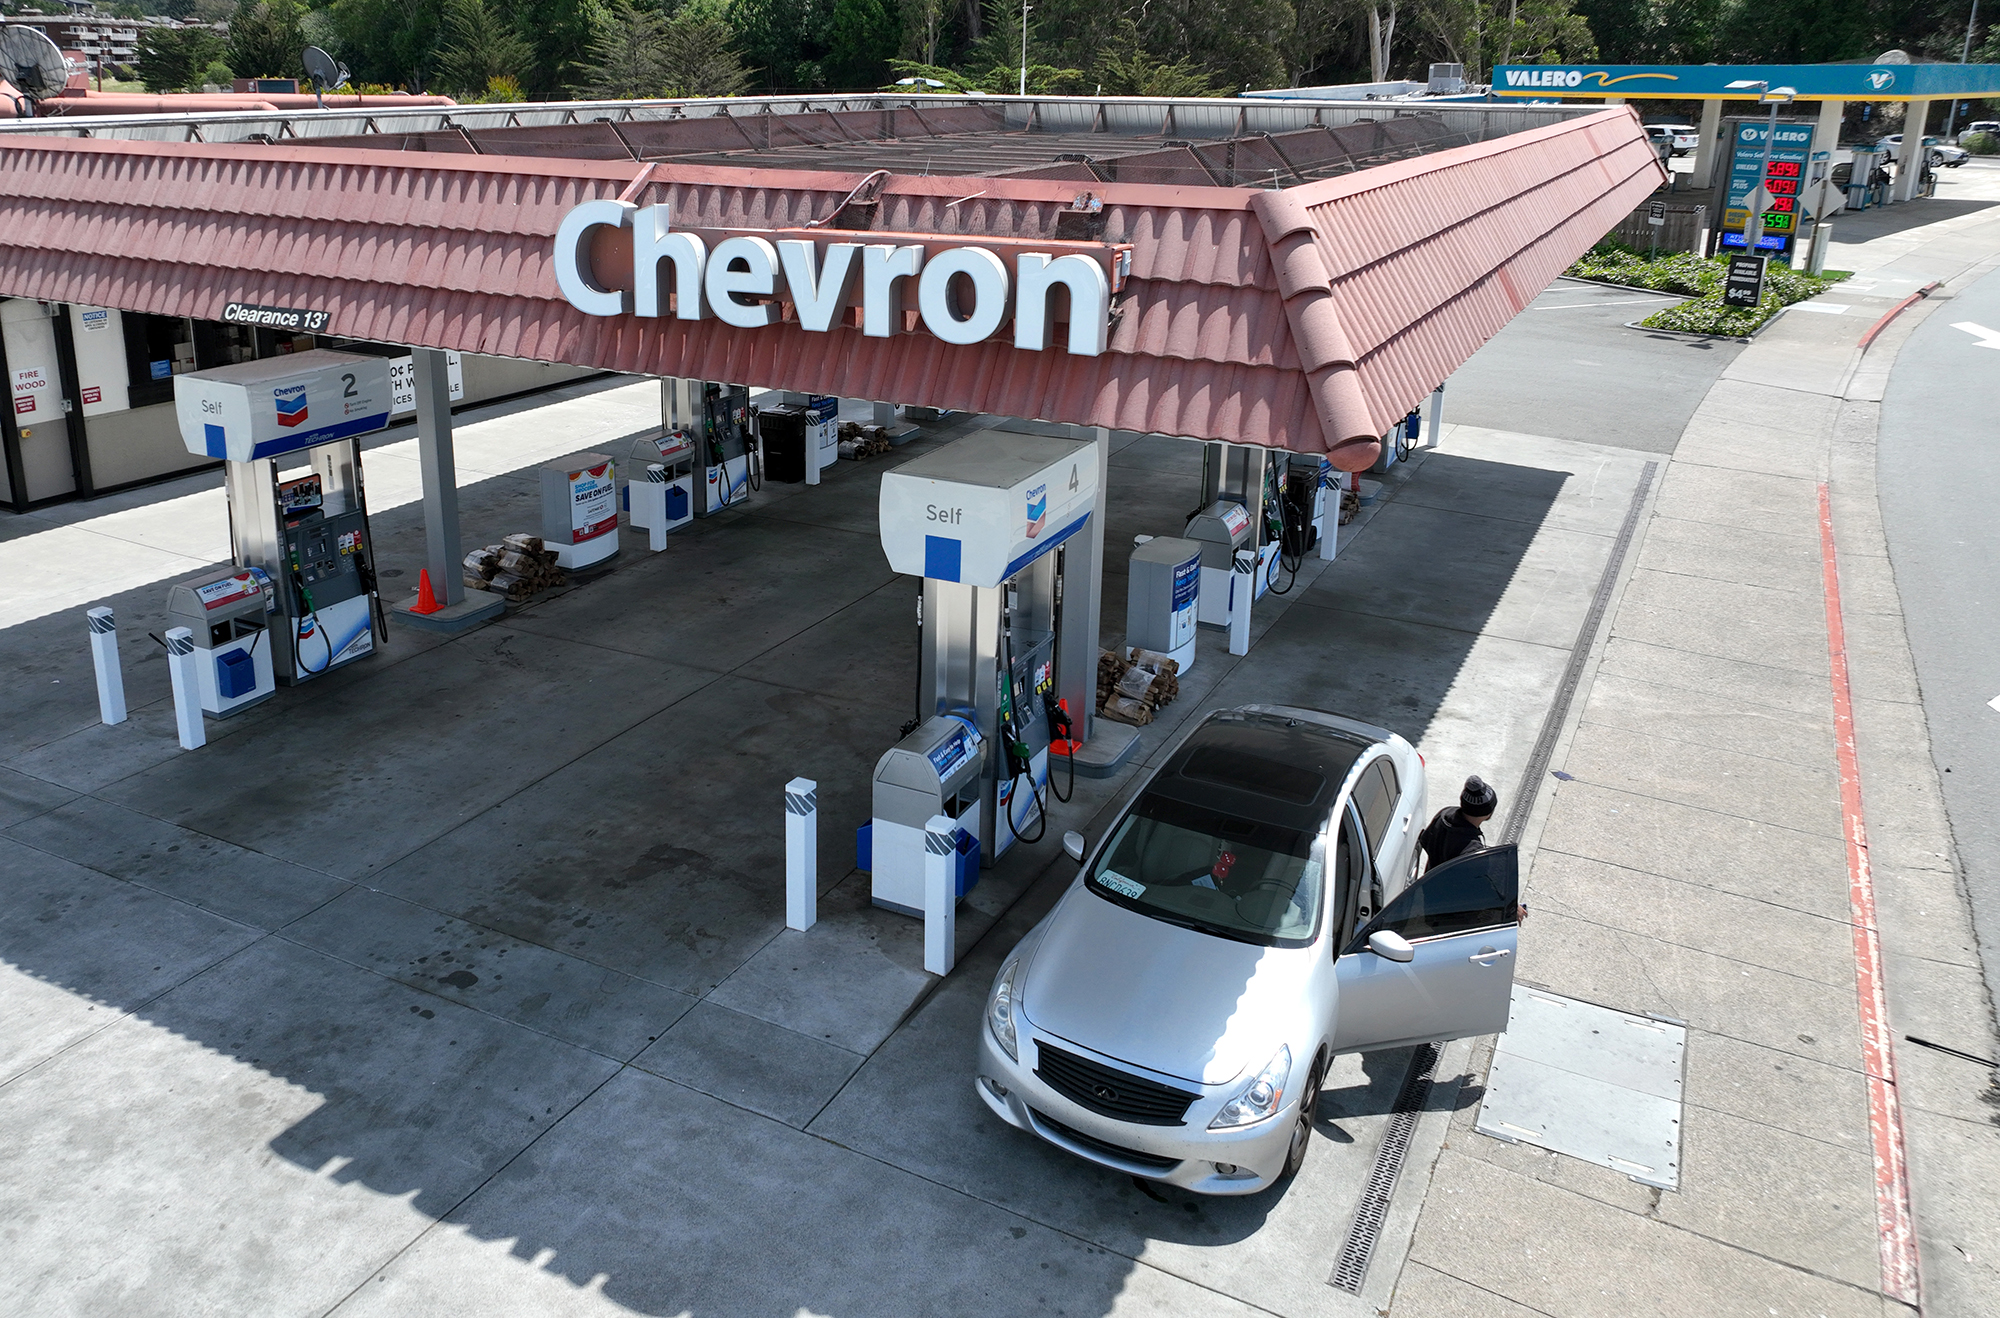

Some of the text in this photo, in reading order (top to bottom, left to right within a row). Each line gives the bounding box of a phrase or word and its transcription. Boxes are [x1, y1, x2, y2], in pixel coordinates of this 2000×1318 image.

[1505, 70, 1583, 88] VALERO
[553, 199, 1110, 358] Chevron
[84, 311, 106, 320] NOTICE
[224, 303, 299, 327] Clearance
[19, 370, 39, 380] FIRE
[15, 380, 46, 391] WOOD
[273, 384, 306, 397] Chevron
[341, 373, 358, 398] 2
[201, 399, 223, 416] Self
[304, 432, 335, 445] TECHRON
[1068, 463, 1079, 493] 4
[575, 490, 593, 502] SAVE
[592, 488, 602, 497] ON
[1026, 483, 1047, 501] Chevron
[926, 504, 962, 525] Self
